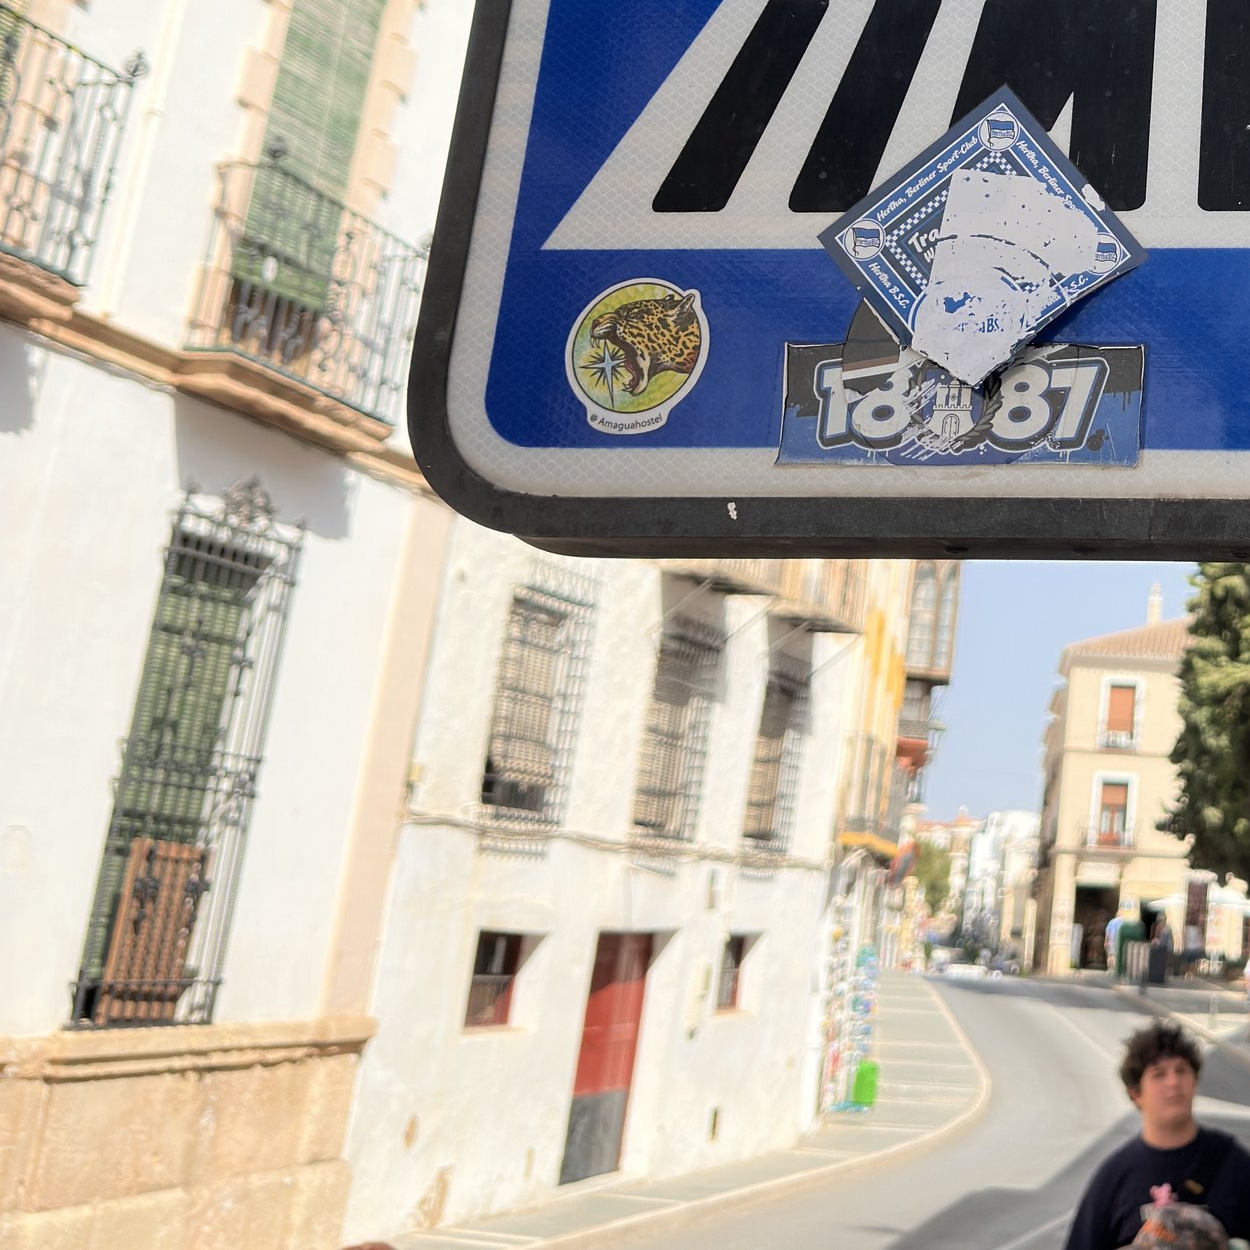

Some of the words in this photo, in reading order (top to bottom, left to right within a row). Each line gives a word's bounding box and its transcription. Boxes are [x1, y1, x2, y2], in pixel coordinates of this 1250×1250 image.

[877, 197, 907, 222] Hertha,
[905, 170, 936, 198] Berliner
[936, 136, 978, 172] Sport-Club
[1015, 140, 1039, 168] Hertha,
[1038, 165, 1065, 195] Berliner
[868, 262, 892, 288] Hertha
[888, 285, 910, 308] B.S.C.
[598, 413, 663, 432] Amaguahostel
